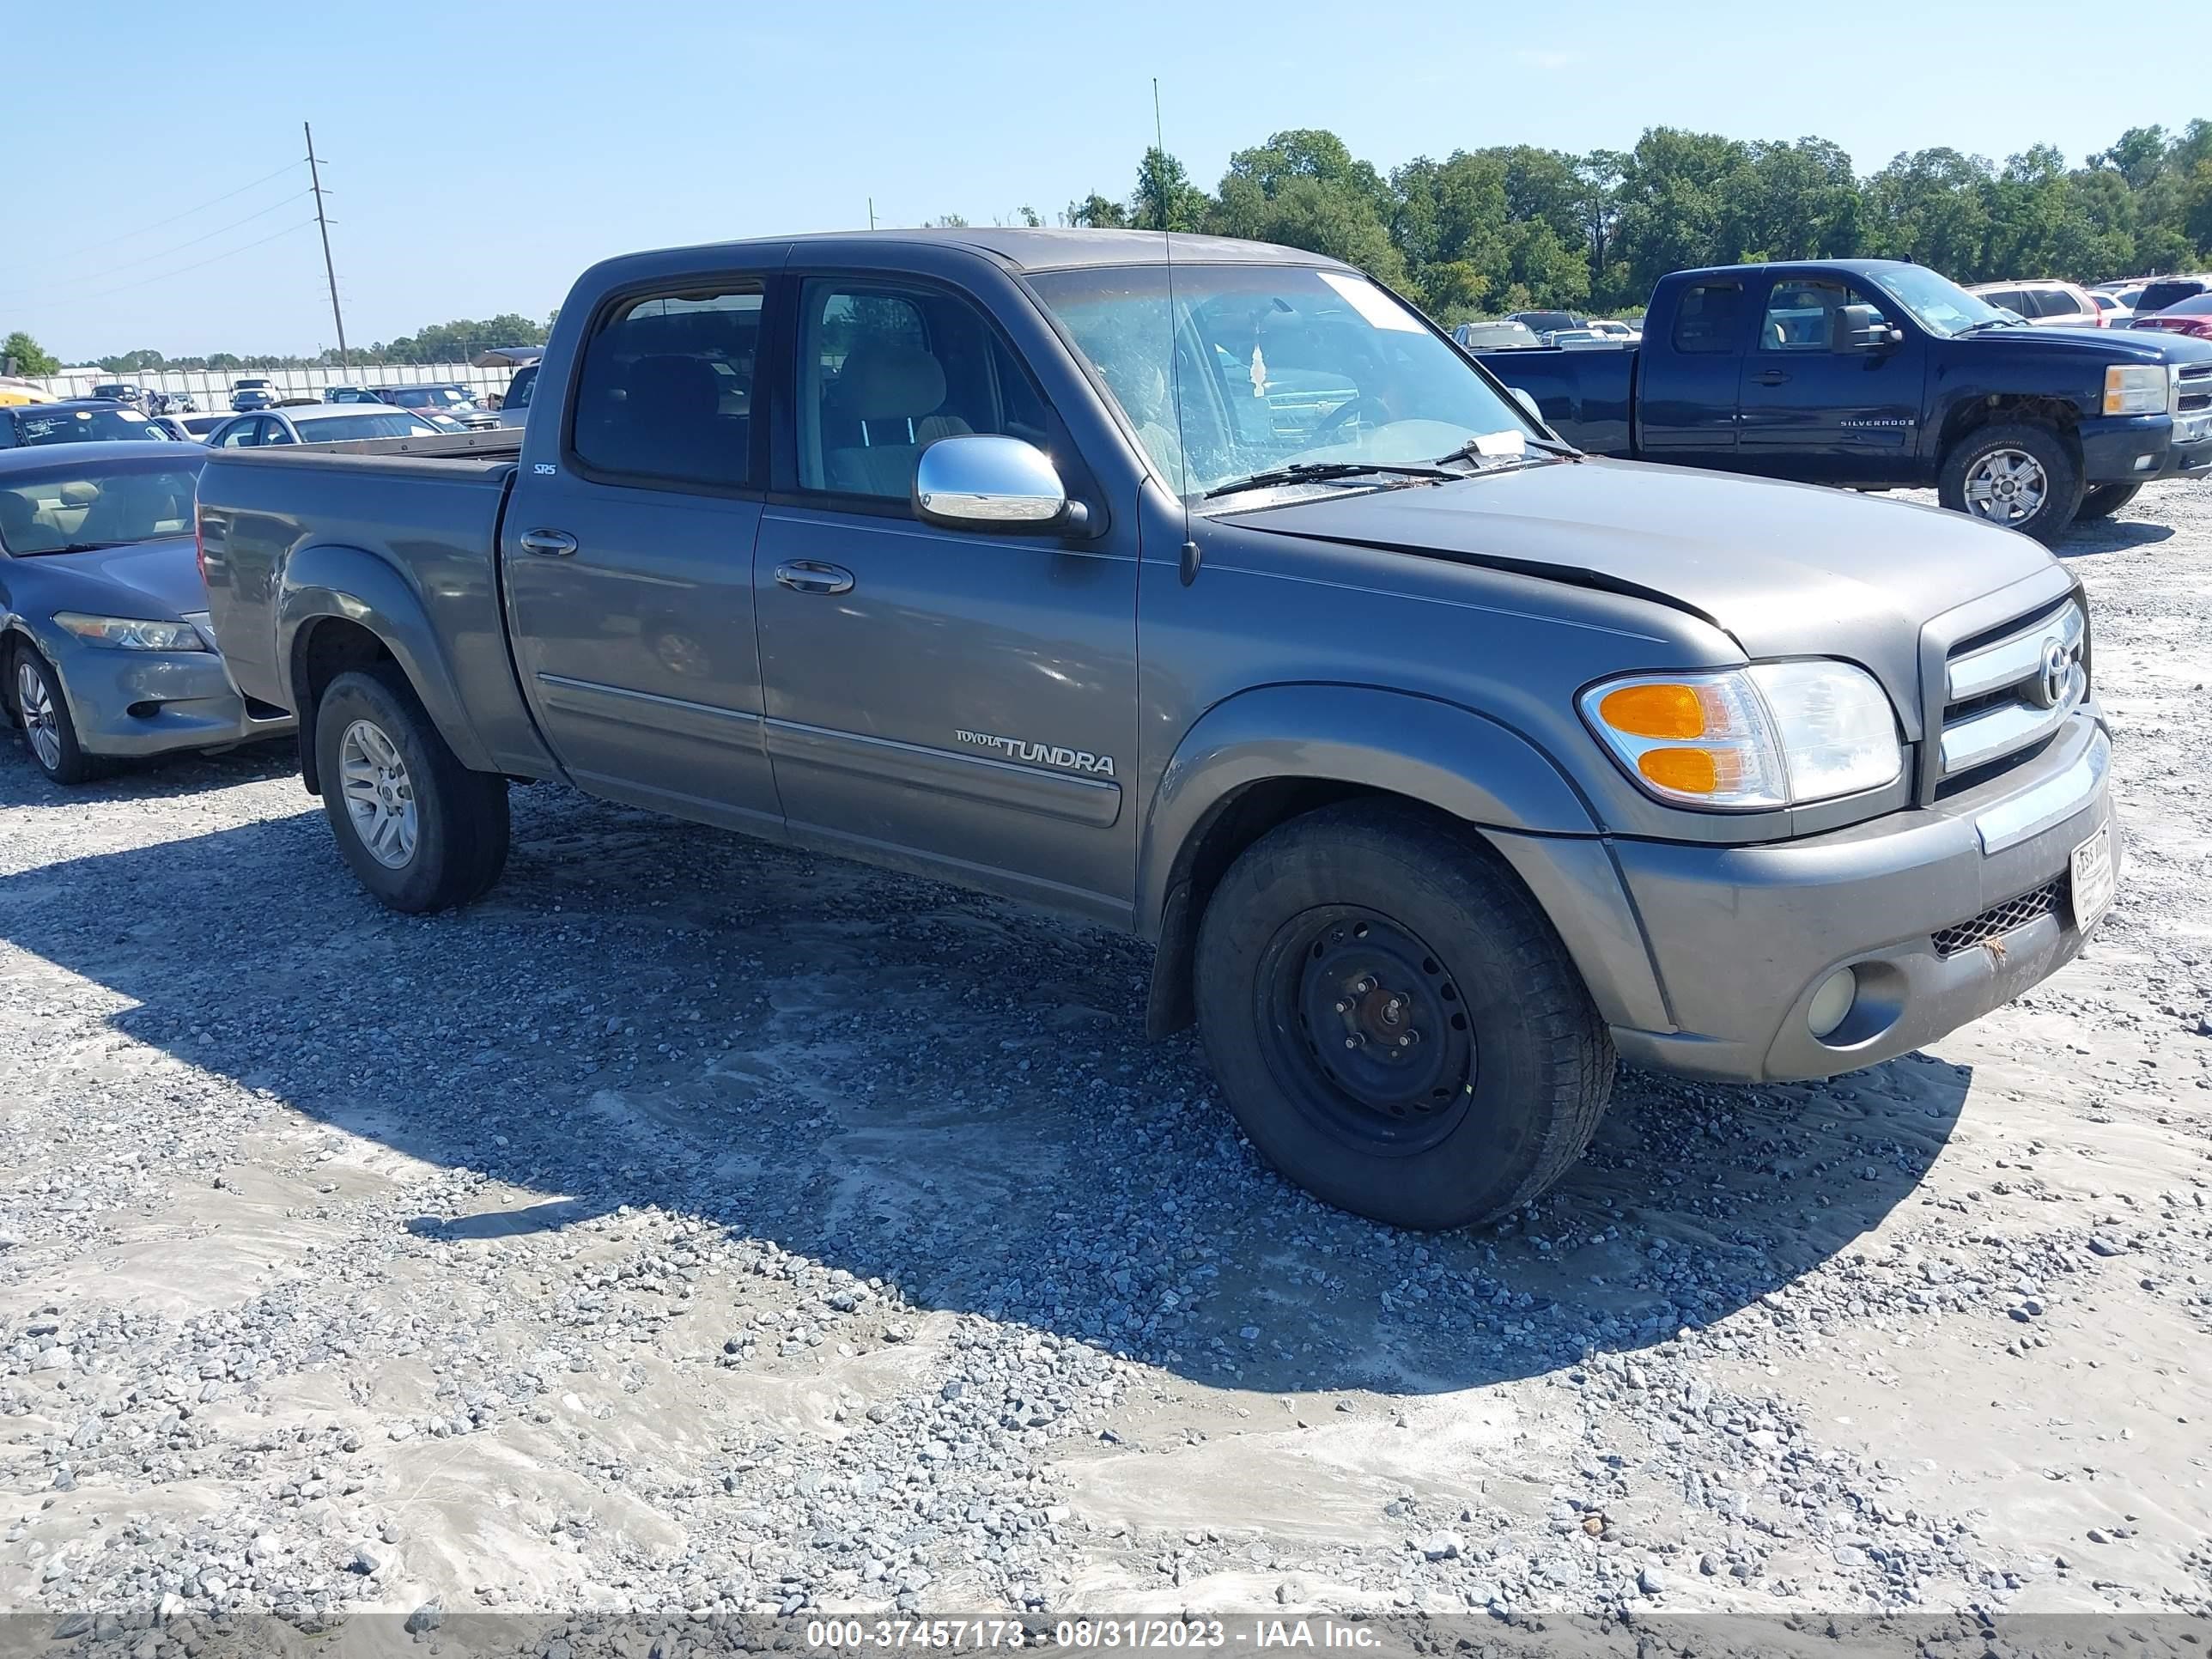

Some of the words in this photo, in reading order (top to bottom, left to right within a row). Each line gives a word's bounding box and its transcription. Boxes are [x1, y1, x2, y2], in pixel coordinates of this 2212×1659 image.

[533, 463, 556, 475] SR5
[954, 729, 1002, 749] TOYOTA
[1000, 737, 1115, 776] TUNDRA
